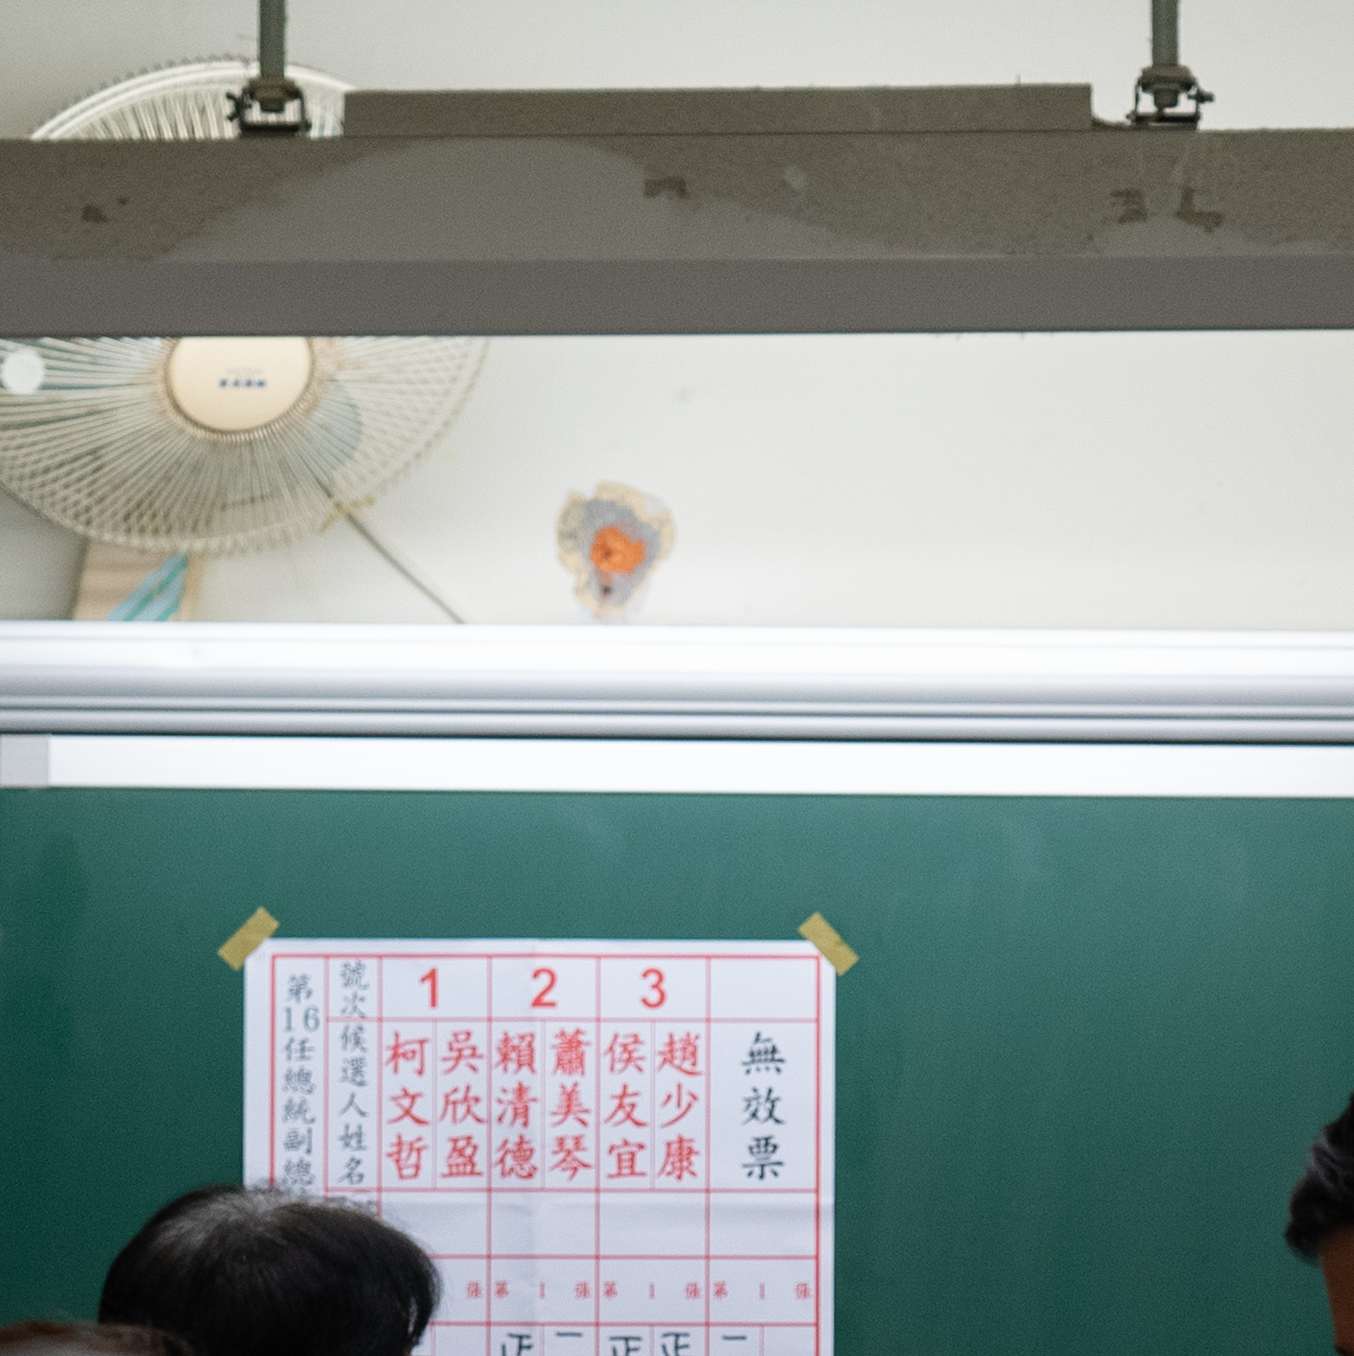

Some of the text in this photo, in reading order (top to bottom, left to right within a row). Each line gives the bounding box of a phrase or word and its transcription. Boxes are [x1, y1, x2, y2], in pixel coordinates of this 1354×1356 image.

[339, 960, 369, 1018] 號次
[420, 966, 667, 1010] 1 2 3
[282, 973, 320, 1194] 第16任總統副總
[337, 1023, 368, 1186] 候選人姓名
[386, 1030, 430, 1181] 柯文哲
[440, 1029, 485, 1180] 吳欣盈
[496, 1031, 538, 1181] 賴清德
[550, 1028, 592, 1182] 蕭美琴
[603, 1031, 648, 1180] 侯友宜
[658, 1031, 705, 1181] 趙少康
[741, 1030, 786, 1182] 無效票
